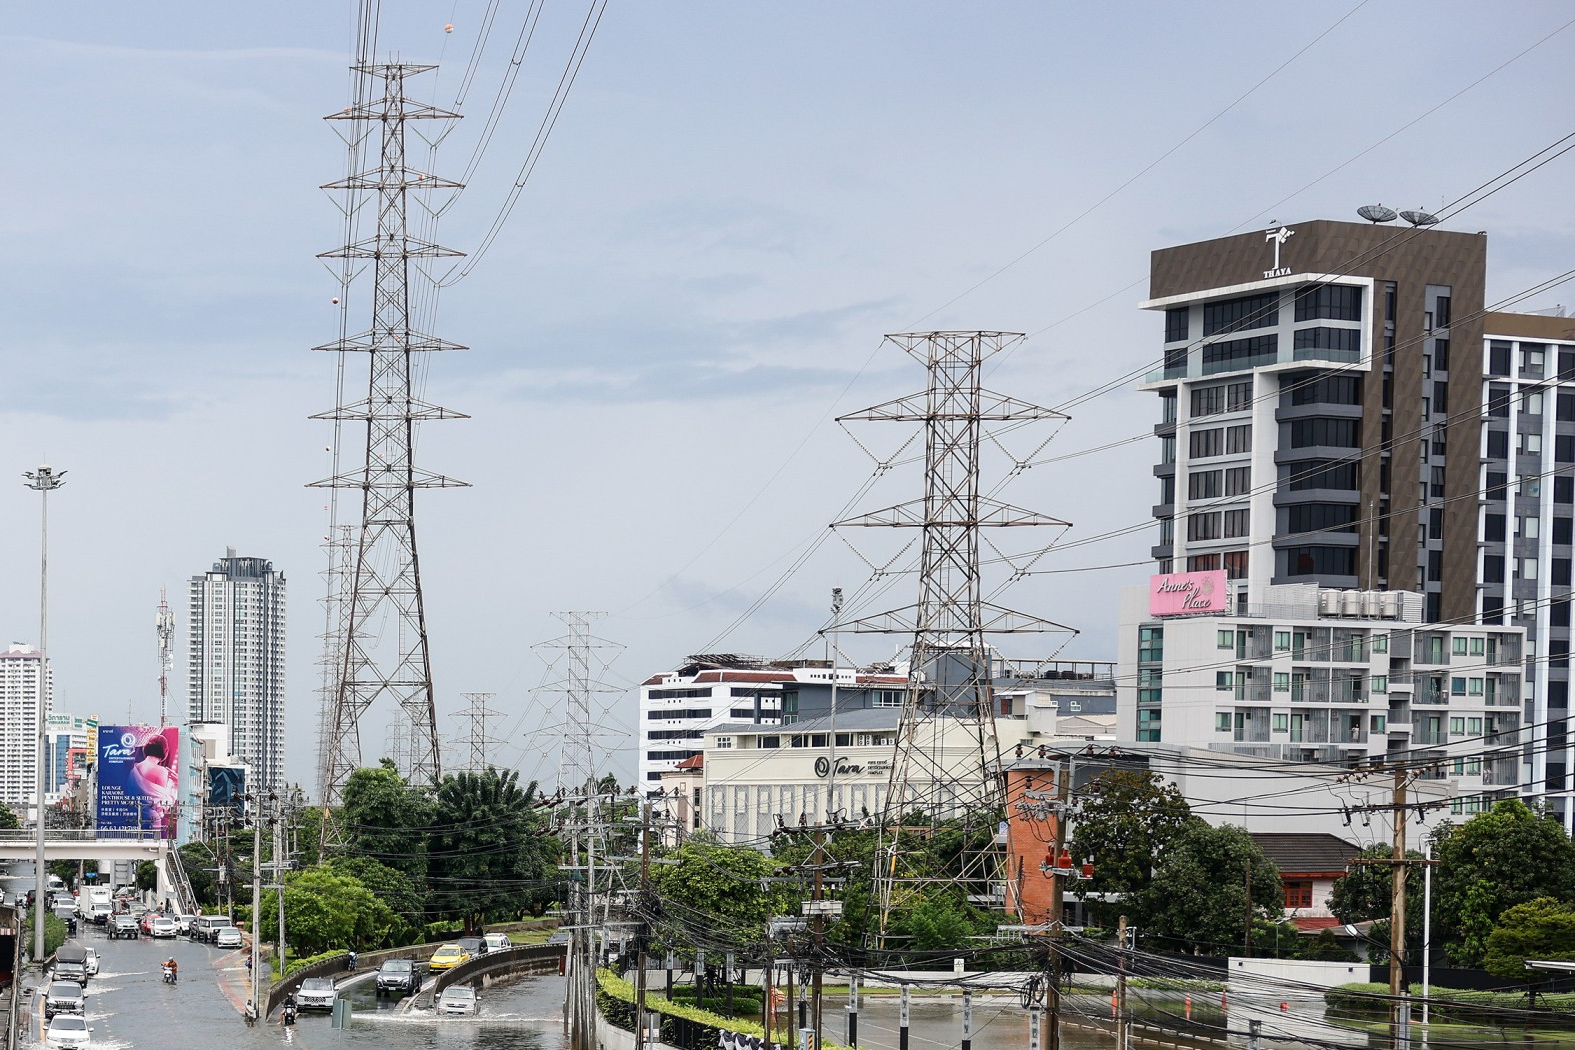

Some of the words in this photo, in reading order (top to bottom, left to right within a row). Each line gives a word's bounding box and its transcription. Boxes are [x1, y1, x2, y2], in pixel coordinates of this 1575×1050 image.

[1263, 267, 1292, 278] THAYA
[1157, 577, 1194, 593] Anne's
[1182, 586, 1211, 609] Place
[102, 744, 136, 758] Tara
[832, 756, 865, 777] Tara
